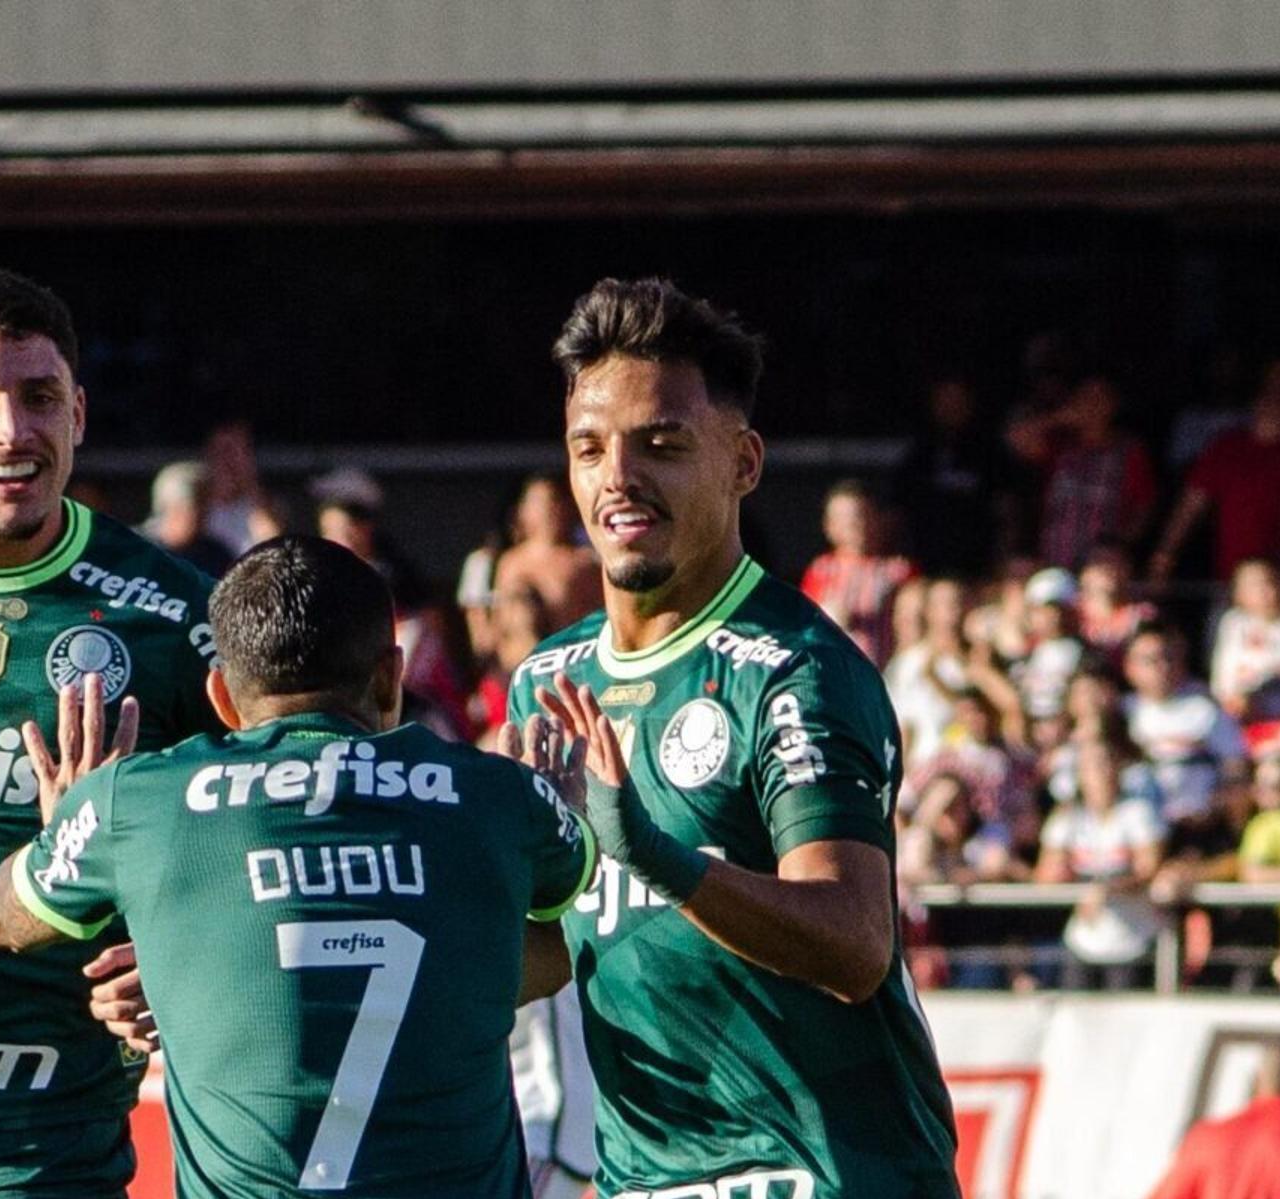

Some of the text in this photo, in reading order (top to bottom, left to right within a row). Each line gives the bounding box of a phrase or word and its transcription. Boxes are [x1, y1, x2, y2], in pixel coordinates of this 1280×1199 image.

[69, 560, 189, 623] crefisa
[185, 741, 460, 816] crefisa
[246, 843, 425, 903] DUDU
[322, 932, 385, 954] crefisa
[276, 919, 426, 1190] 7
